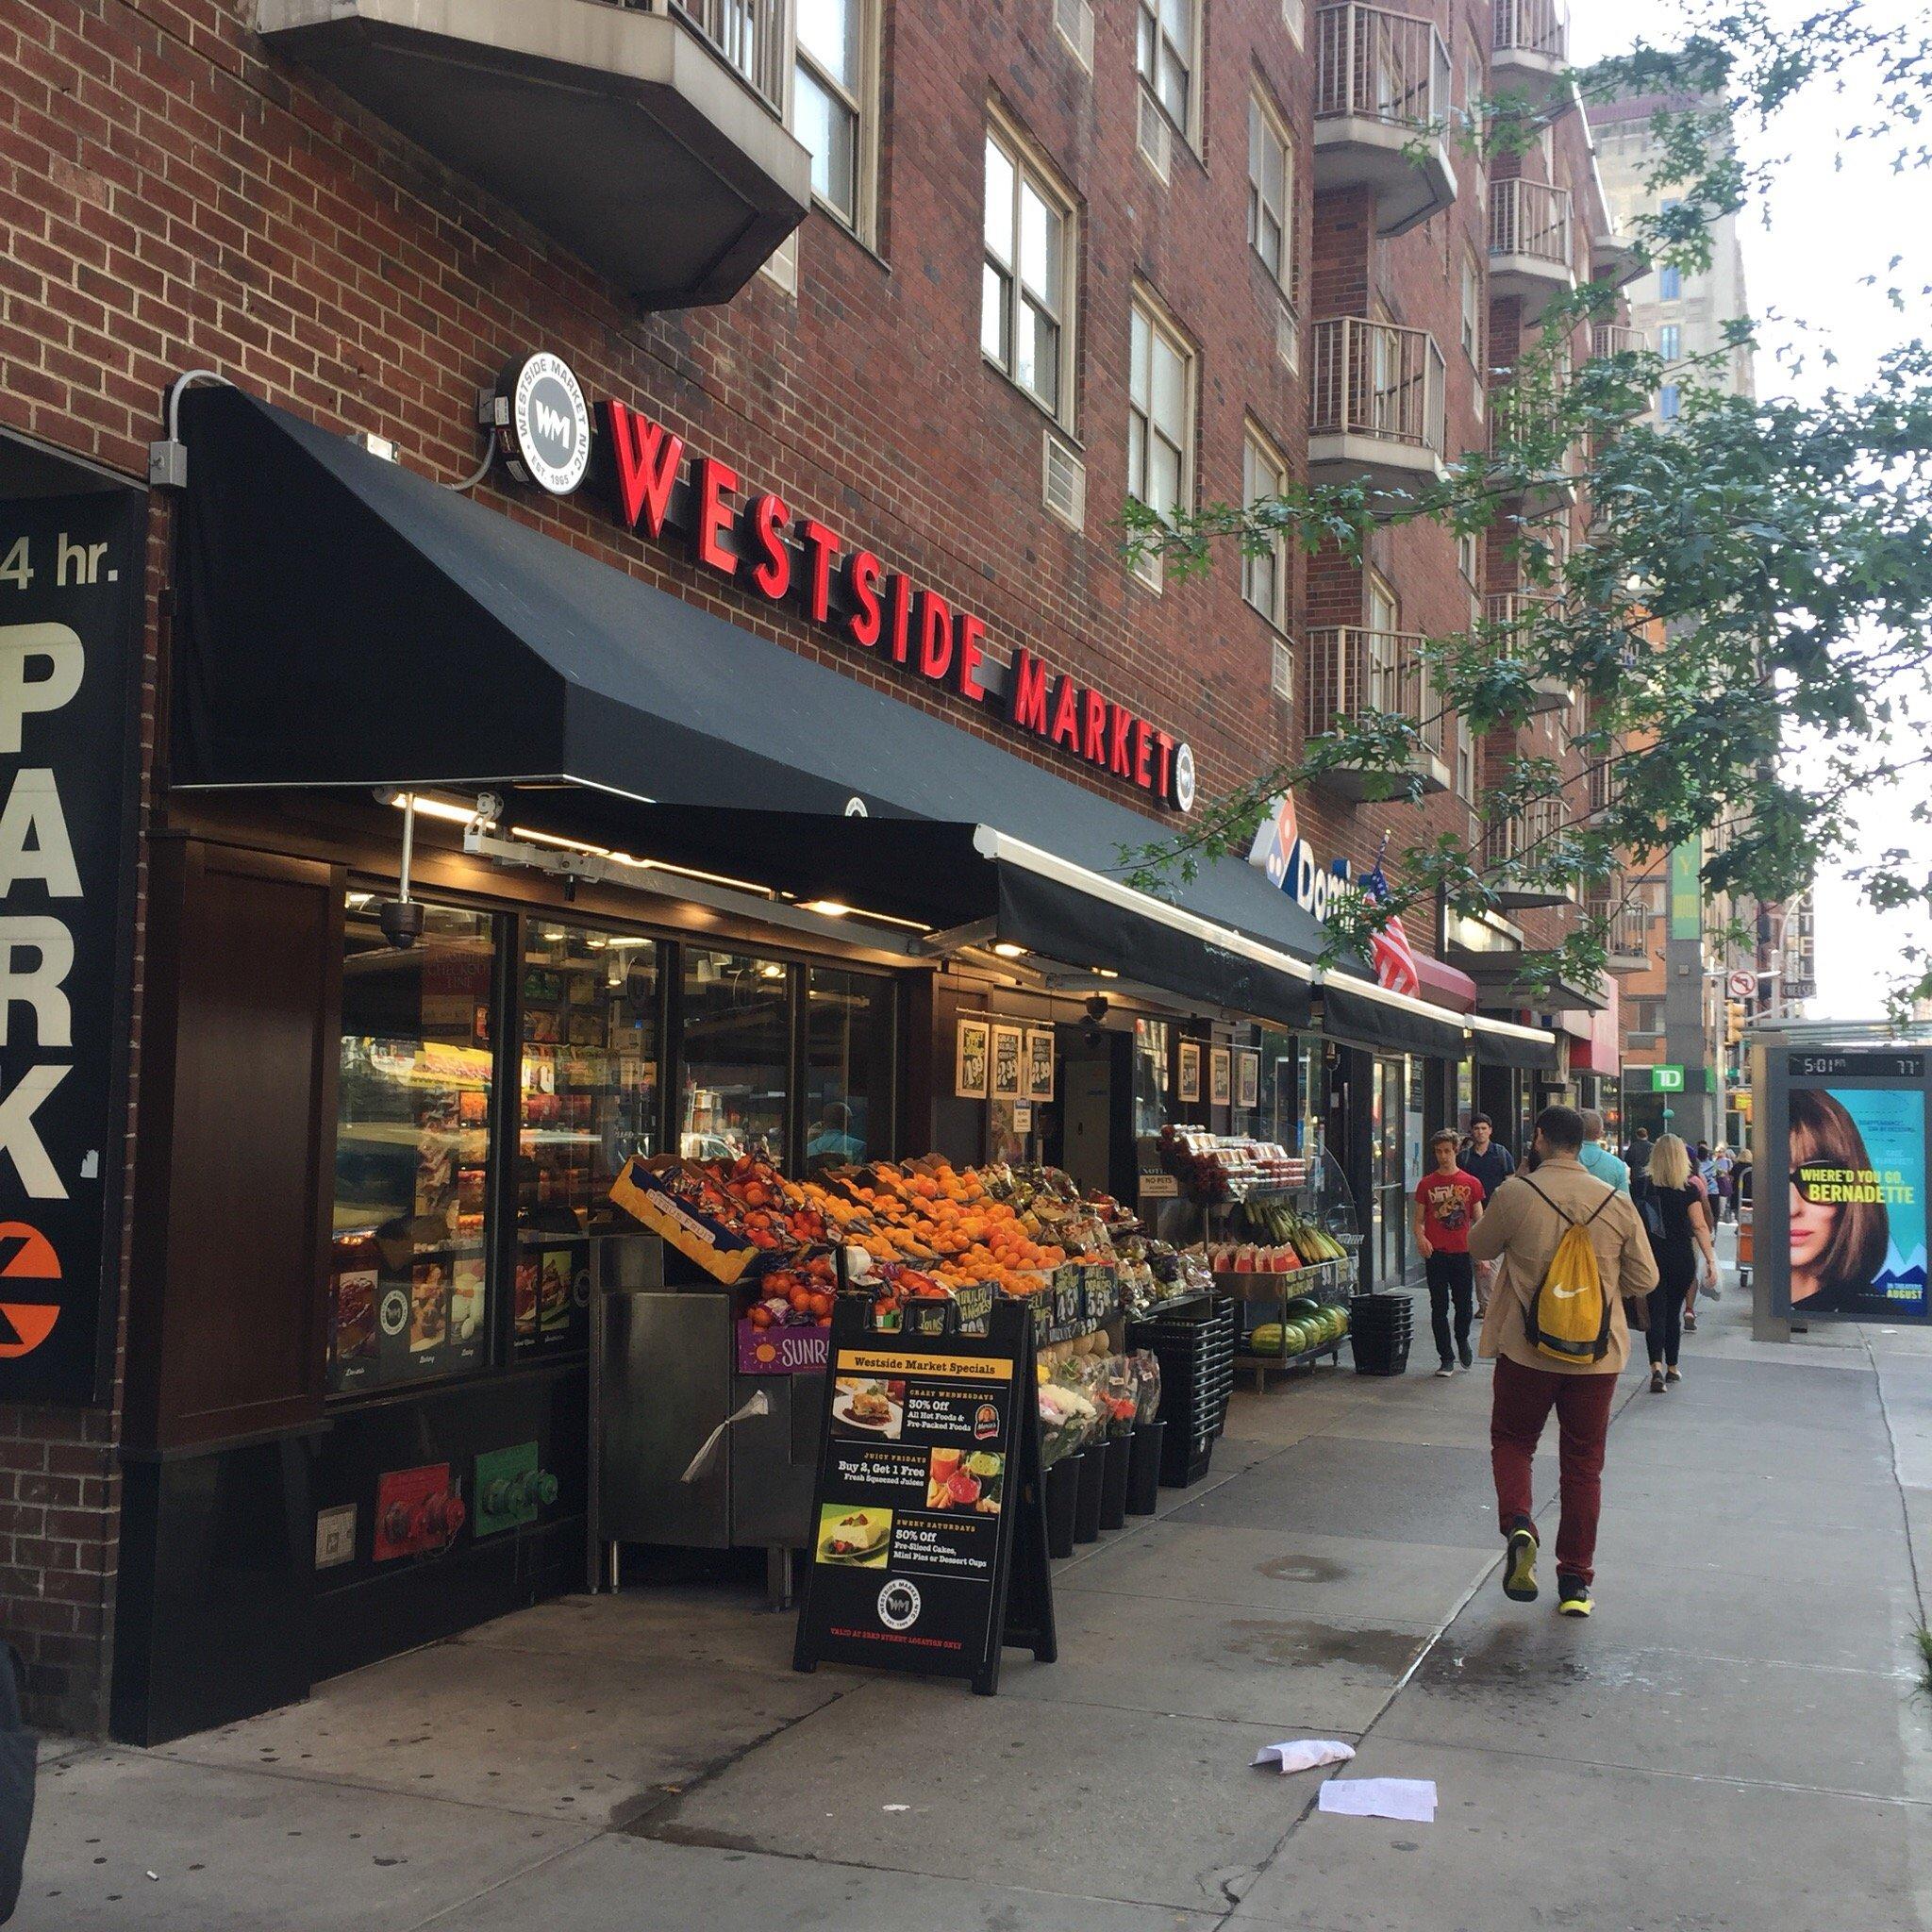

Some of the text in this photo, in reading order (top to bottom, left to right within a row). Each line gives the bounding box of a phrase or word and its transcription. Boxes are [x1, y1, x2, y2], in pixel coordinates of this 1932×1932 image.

[520, 358, 588, 472] WESTSIDE MARKET NYC
[550, 474, 570, 486] 1965
[57, 532, 118, 587] hr.
[608, 398, 1175, 798] WESTSIDE MARKET
[1804, 1058, 1833, 1073] 5:01
[1656, 1070, 1681, 1087] TD
[1800, 1169, 1854, 1183] WHERE'D
[1857, 1170, 1882, 1184] YOU
[1808, 1184, 1915, 1205] BERNADETTE
[1887, 1290, 1923, 1299] AUGUST
[854, 1357, 995, 1375] Westside Market Specials
[939, 1391, 994, 1401] WEDNESDAYS
[932, 1401, 950, 1411] Off
[935, 1413, 957, 1422] Foods
[907, 1420, 971, 1431] Pre-Packed Foods
[891, 1455, 926, 1463] FRIDAYS
[838, 1460, 924, 1477] Buy 2, Get 1 Free
[844, 1473, 924, 1487] Fresh Squeezed Juices
[896, 1519, 975, 1532] SWEET SATURDAYS
[920, 1532, 938, 1542] Off
[894, 1541, 957, 1557] Pre-Sliced Cakes,
[893, 1551, 911, 1559] Mini
[912, 1553, 928, 1561] Pies
[940, 1556, 967, 1565] Dessert
[968, 1558, 987, 1569] Cups
[943, 1641, 962, 1650] ONLY
